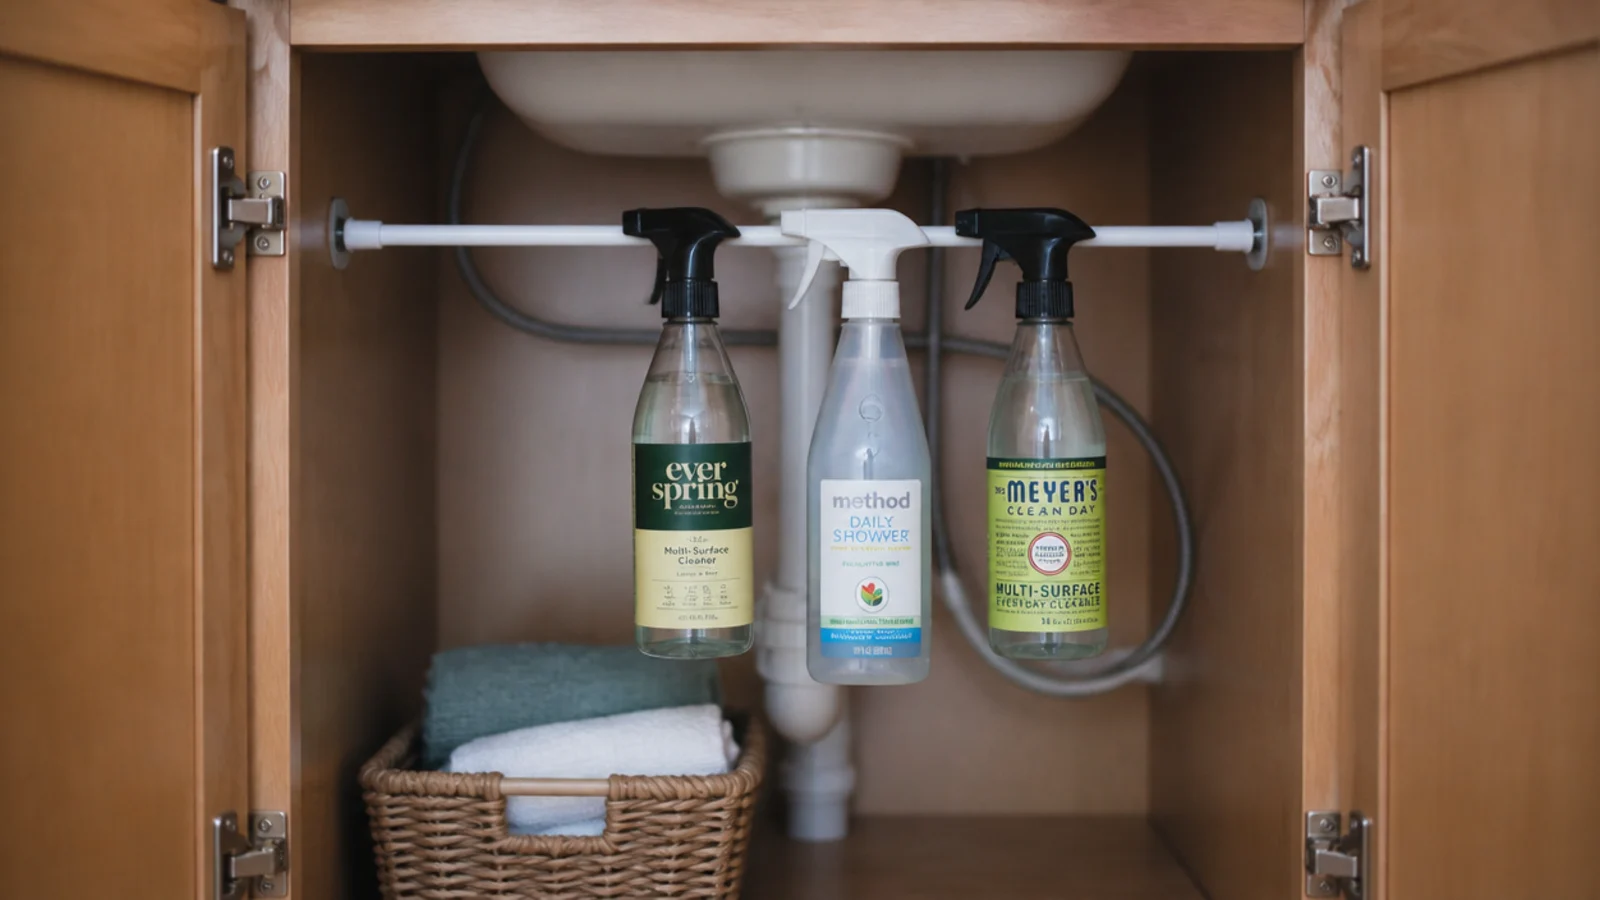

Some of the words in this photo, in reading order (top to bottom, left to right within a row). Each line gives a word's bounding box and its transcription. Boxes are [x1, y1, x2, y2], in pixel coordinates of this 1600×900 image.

[665, 462, 727, 481] ever
[652, 480, 737, 509] spring
[833, 491, 910, 509] method
[1007, 480, 1098, 503] MEYER'S
[1069, 504, 1095, 515] DAY
[850, 516, 893, 528] DAILY
[996, 582, 1100, 597] MULTI-SURFACE
